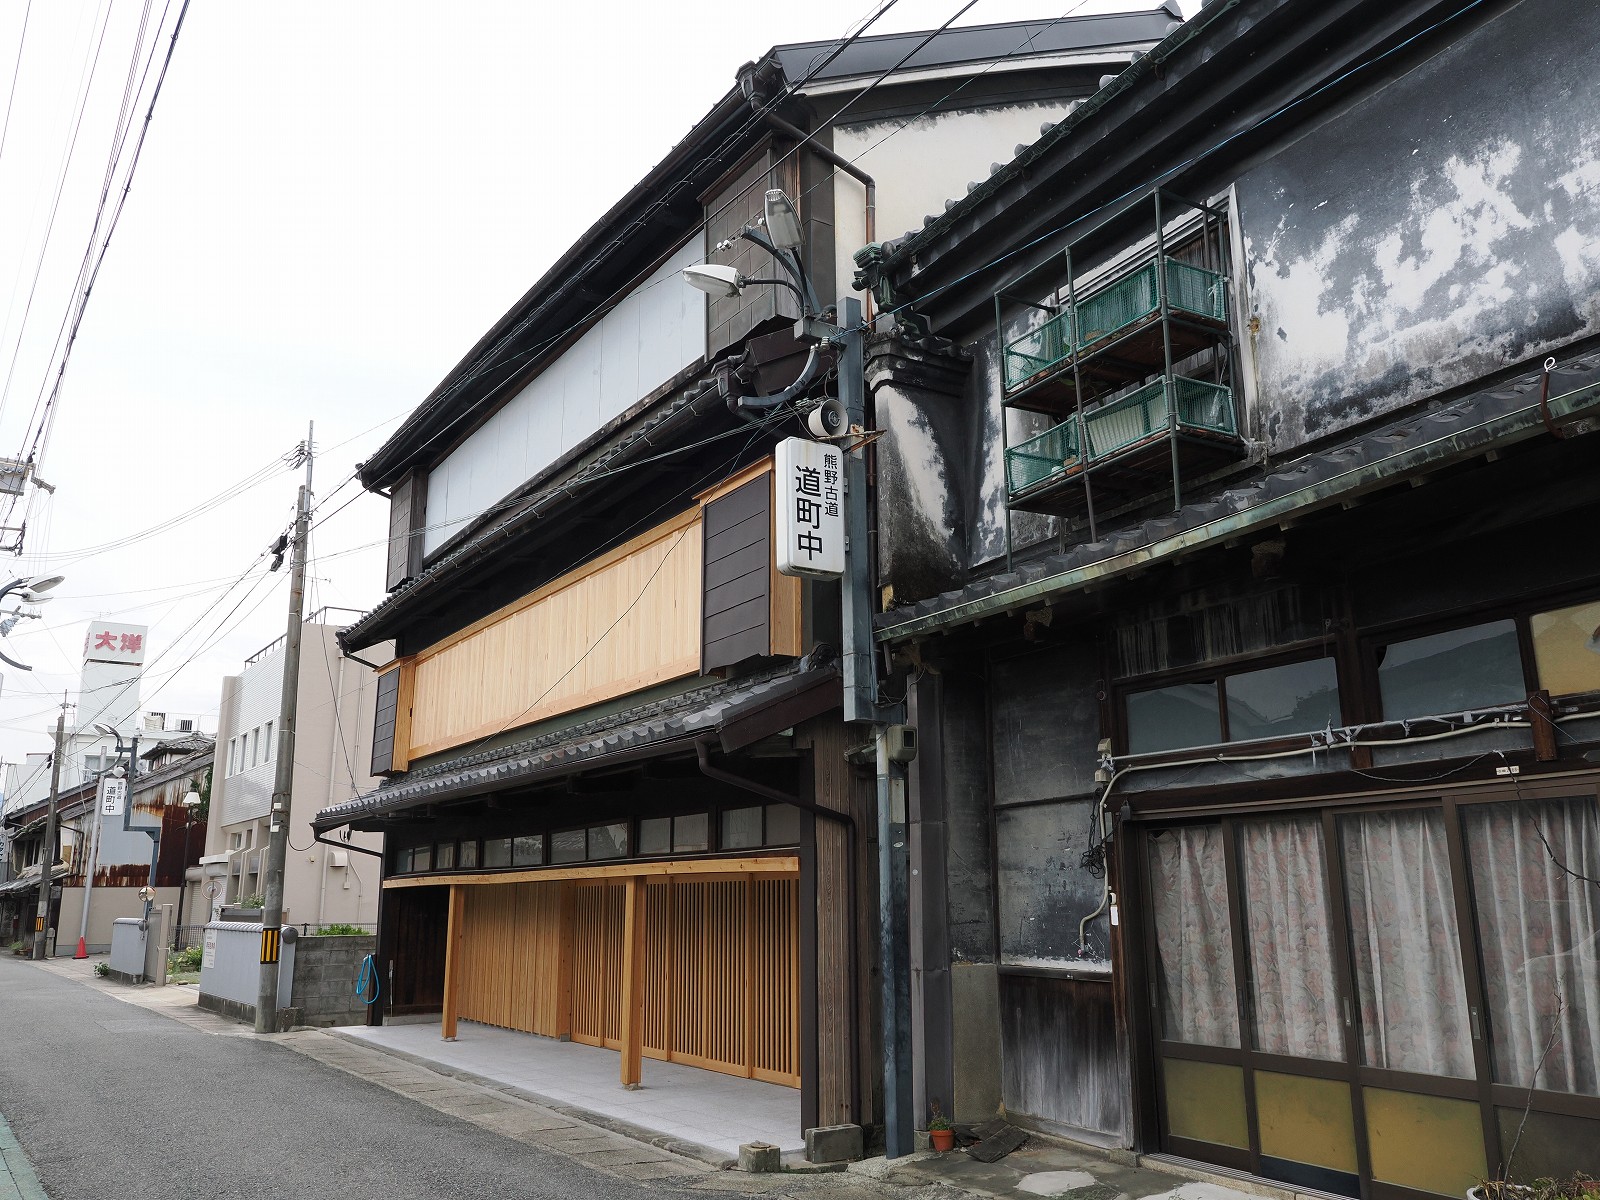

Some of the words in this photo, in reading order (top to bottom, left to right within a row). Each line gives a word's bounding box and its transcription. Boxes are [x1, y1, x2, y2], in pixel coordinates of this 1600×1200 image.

[795, 465, 823, 561] 道町中
[824, 453, 839, 517] 熊野古道
[94, 630, 142, 654] 大洋
